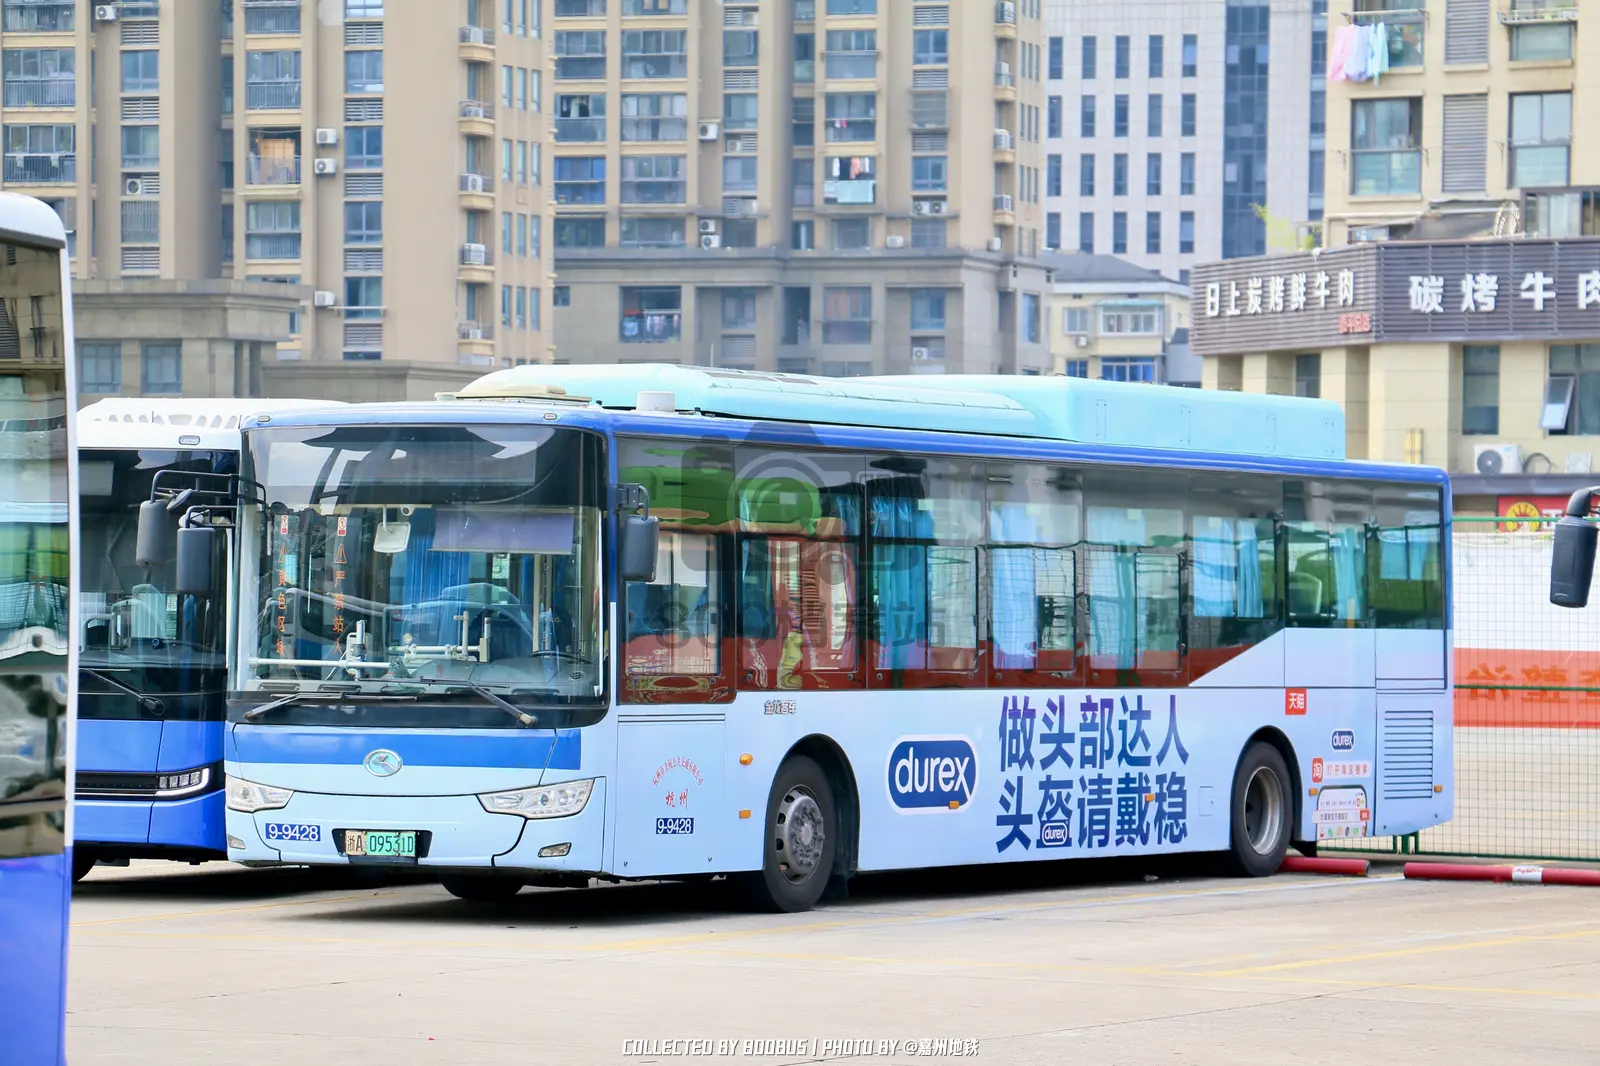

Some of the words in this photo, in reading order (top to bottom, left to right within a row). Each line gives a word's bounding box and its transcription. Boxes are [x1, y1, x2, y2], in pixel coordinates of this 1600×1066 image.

[1205, 268, 1355, 318] 日上炭烤鲜牛肉
[333, 570, 345, 655] 严禁站人
[1288, 692, 1305, 709] 天猫
[998, 694, 1190, 773] 做头部达人
[1332, 732, 1353, 748] durex
[894, 746, 972, 796] durex
[1313, 762, 1323, 779] 淘
[665, 788, 689, 809] 杭州
[996, 771, 1189, 853] 头盔请戴稳
[268, 824, 319, 841] 9-9428
[657, 818, 692, 834] 9-9428
[1044, 826, 1065, 841] durex
